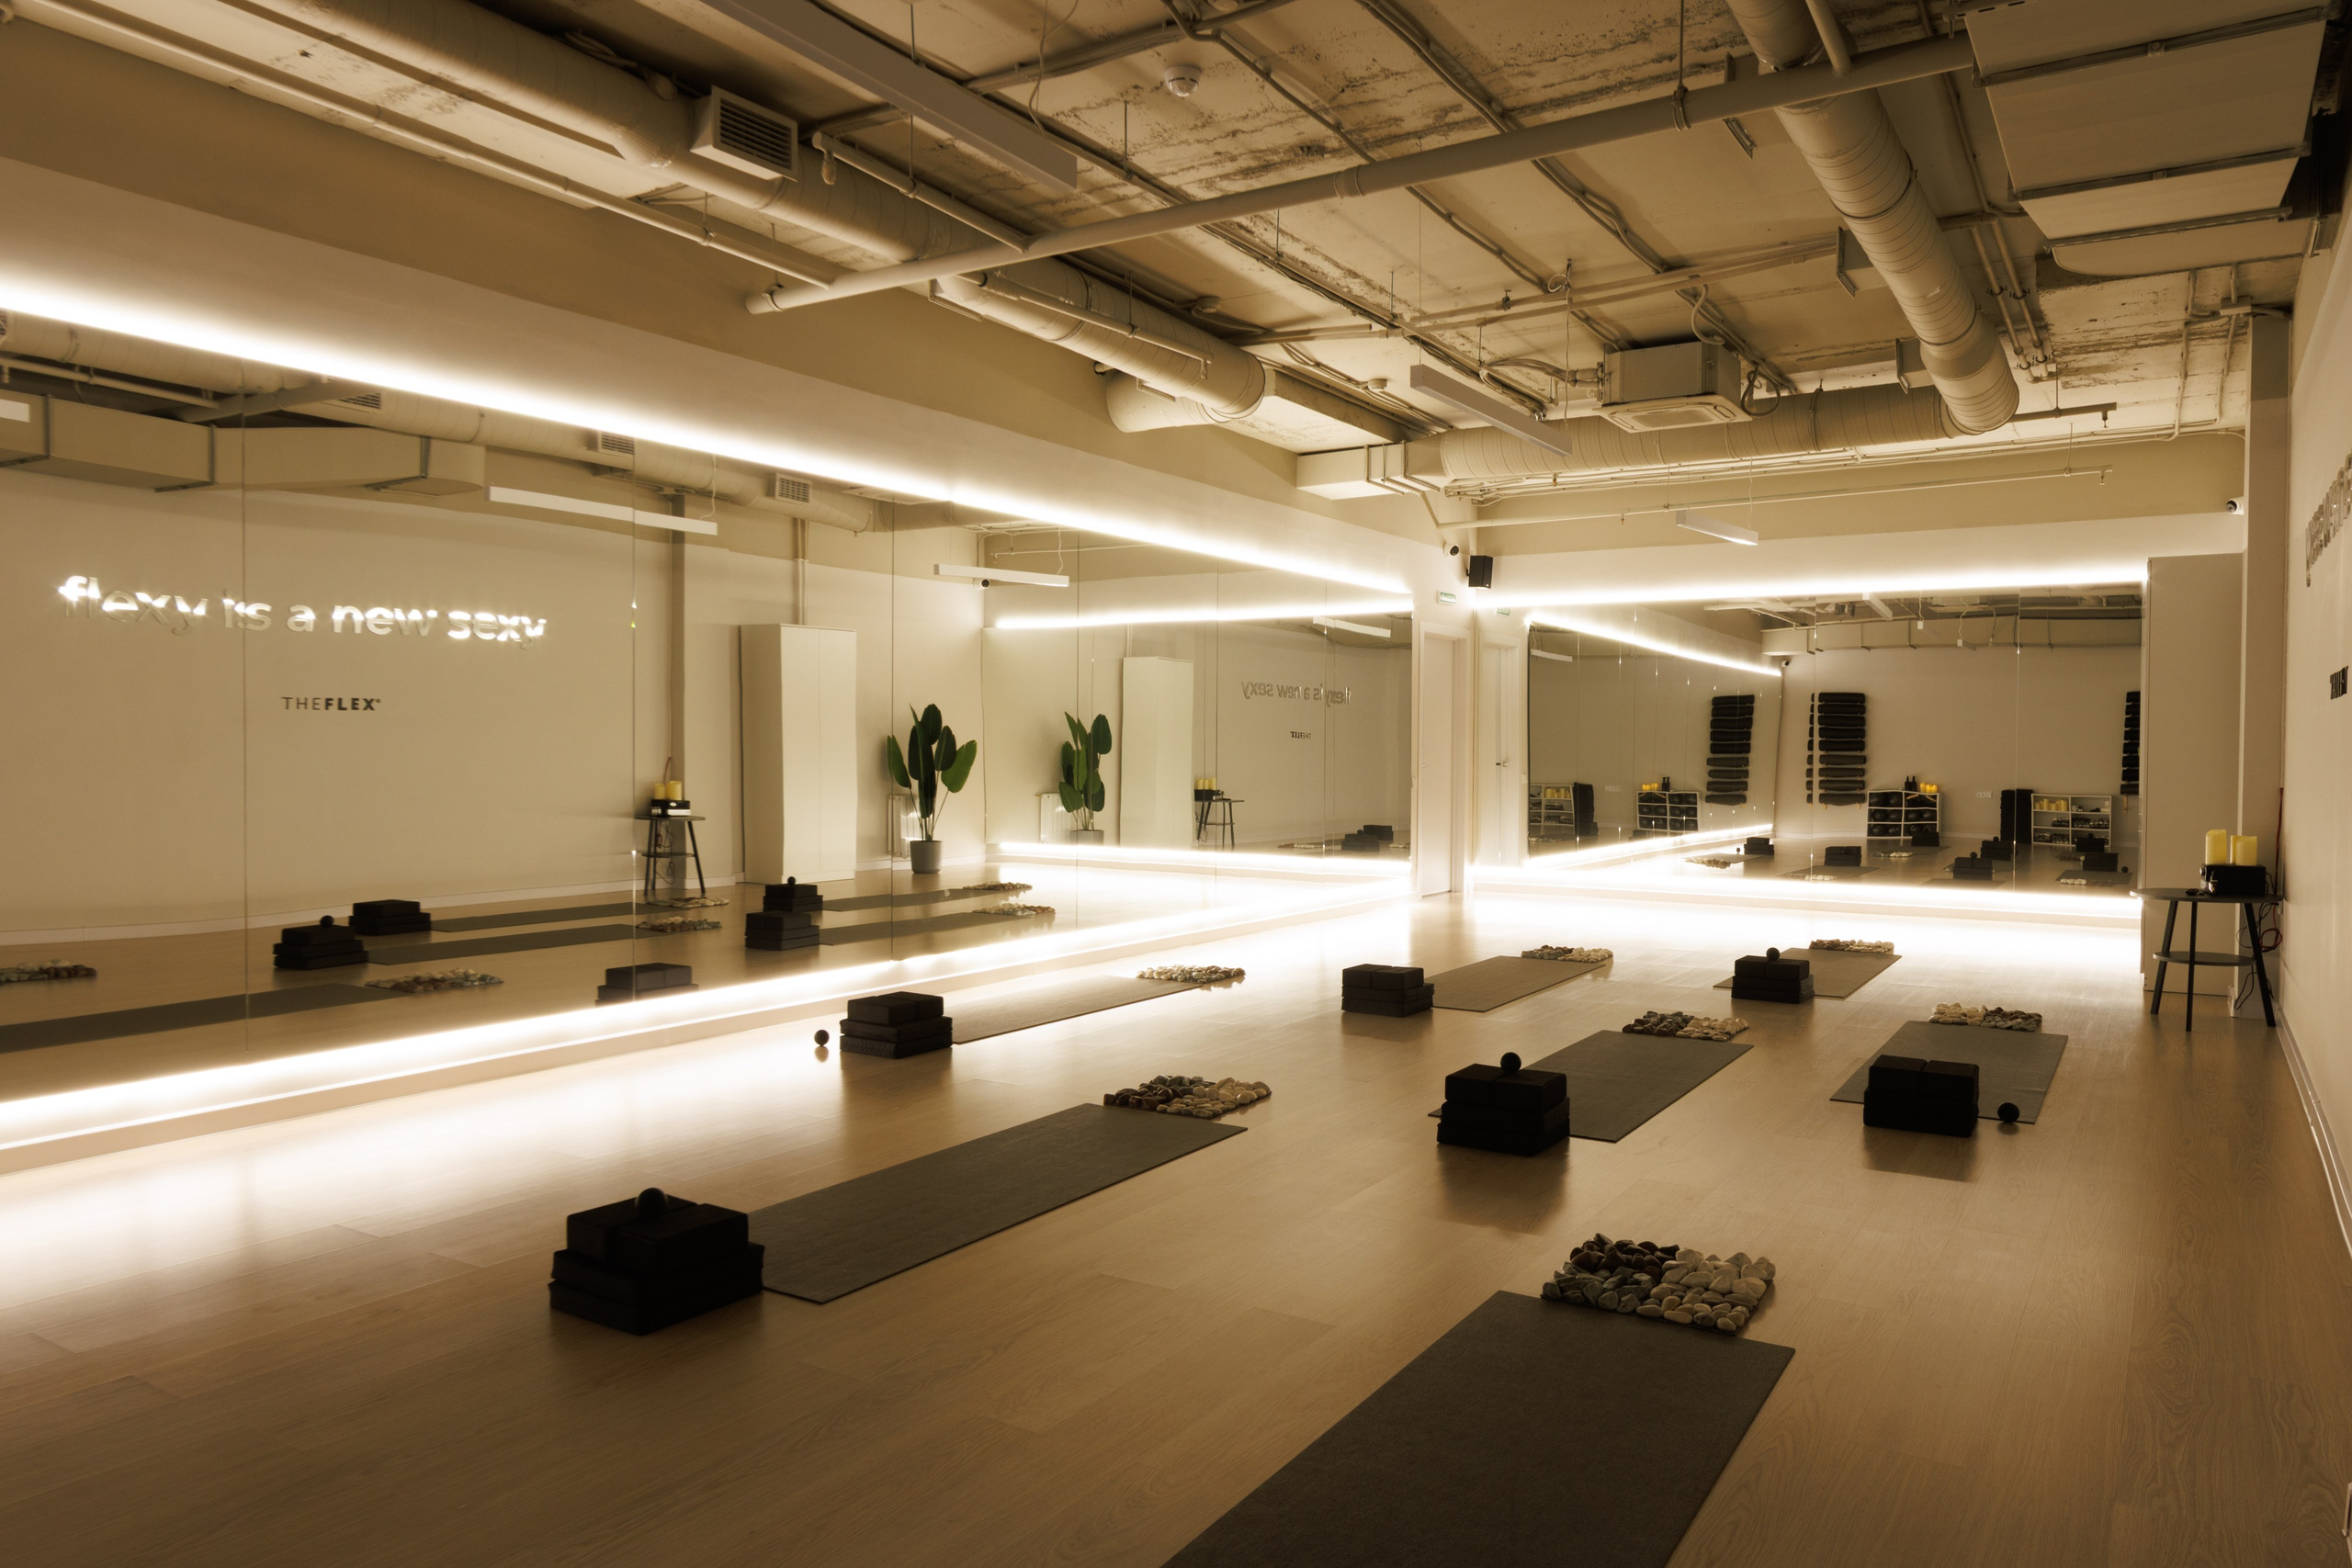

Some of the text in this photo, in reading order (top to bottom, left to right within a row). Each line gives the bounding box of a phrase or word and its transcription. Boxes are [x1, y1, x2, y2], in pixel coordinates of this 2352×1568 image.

[58, 575, 547, 650] flexy is a new sexy
